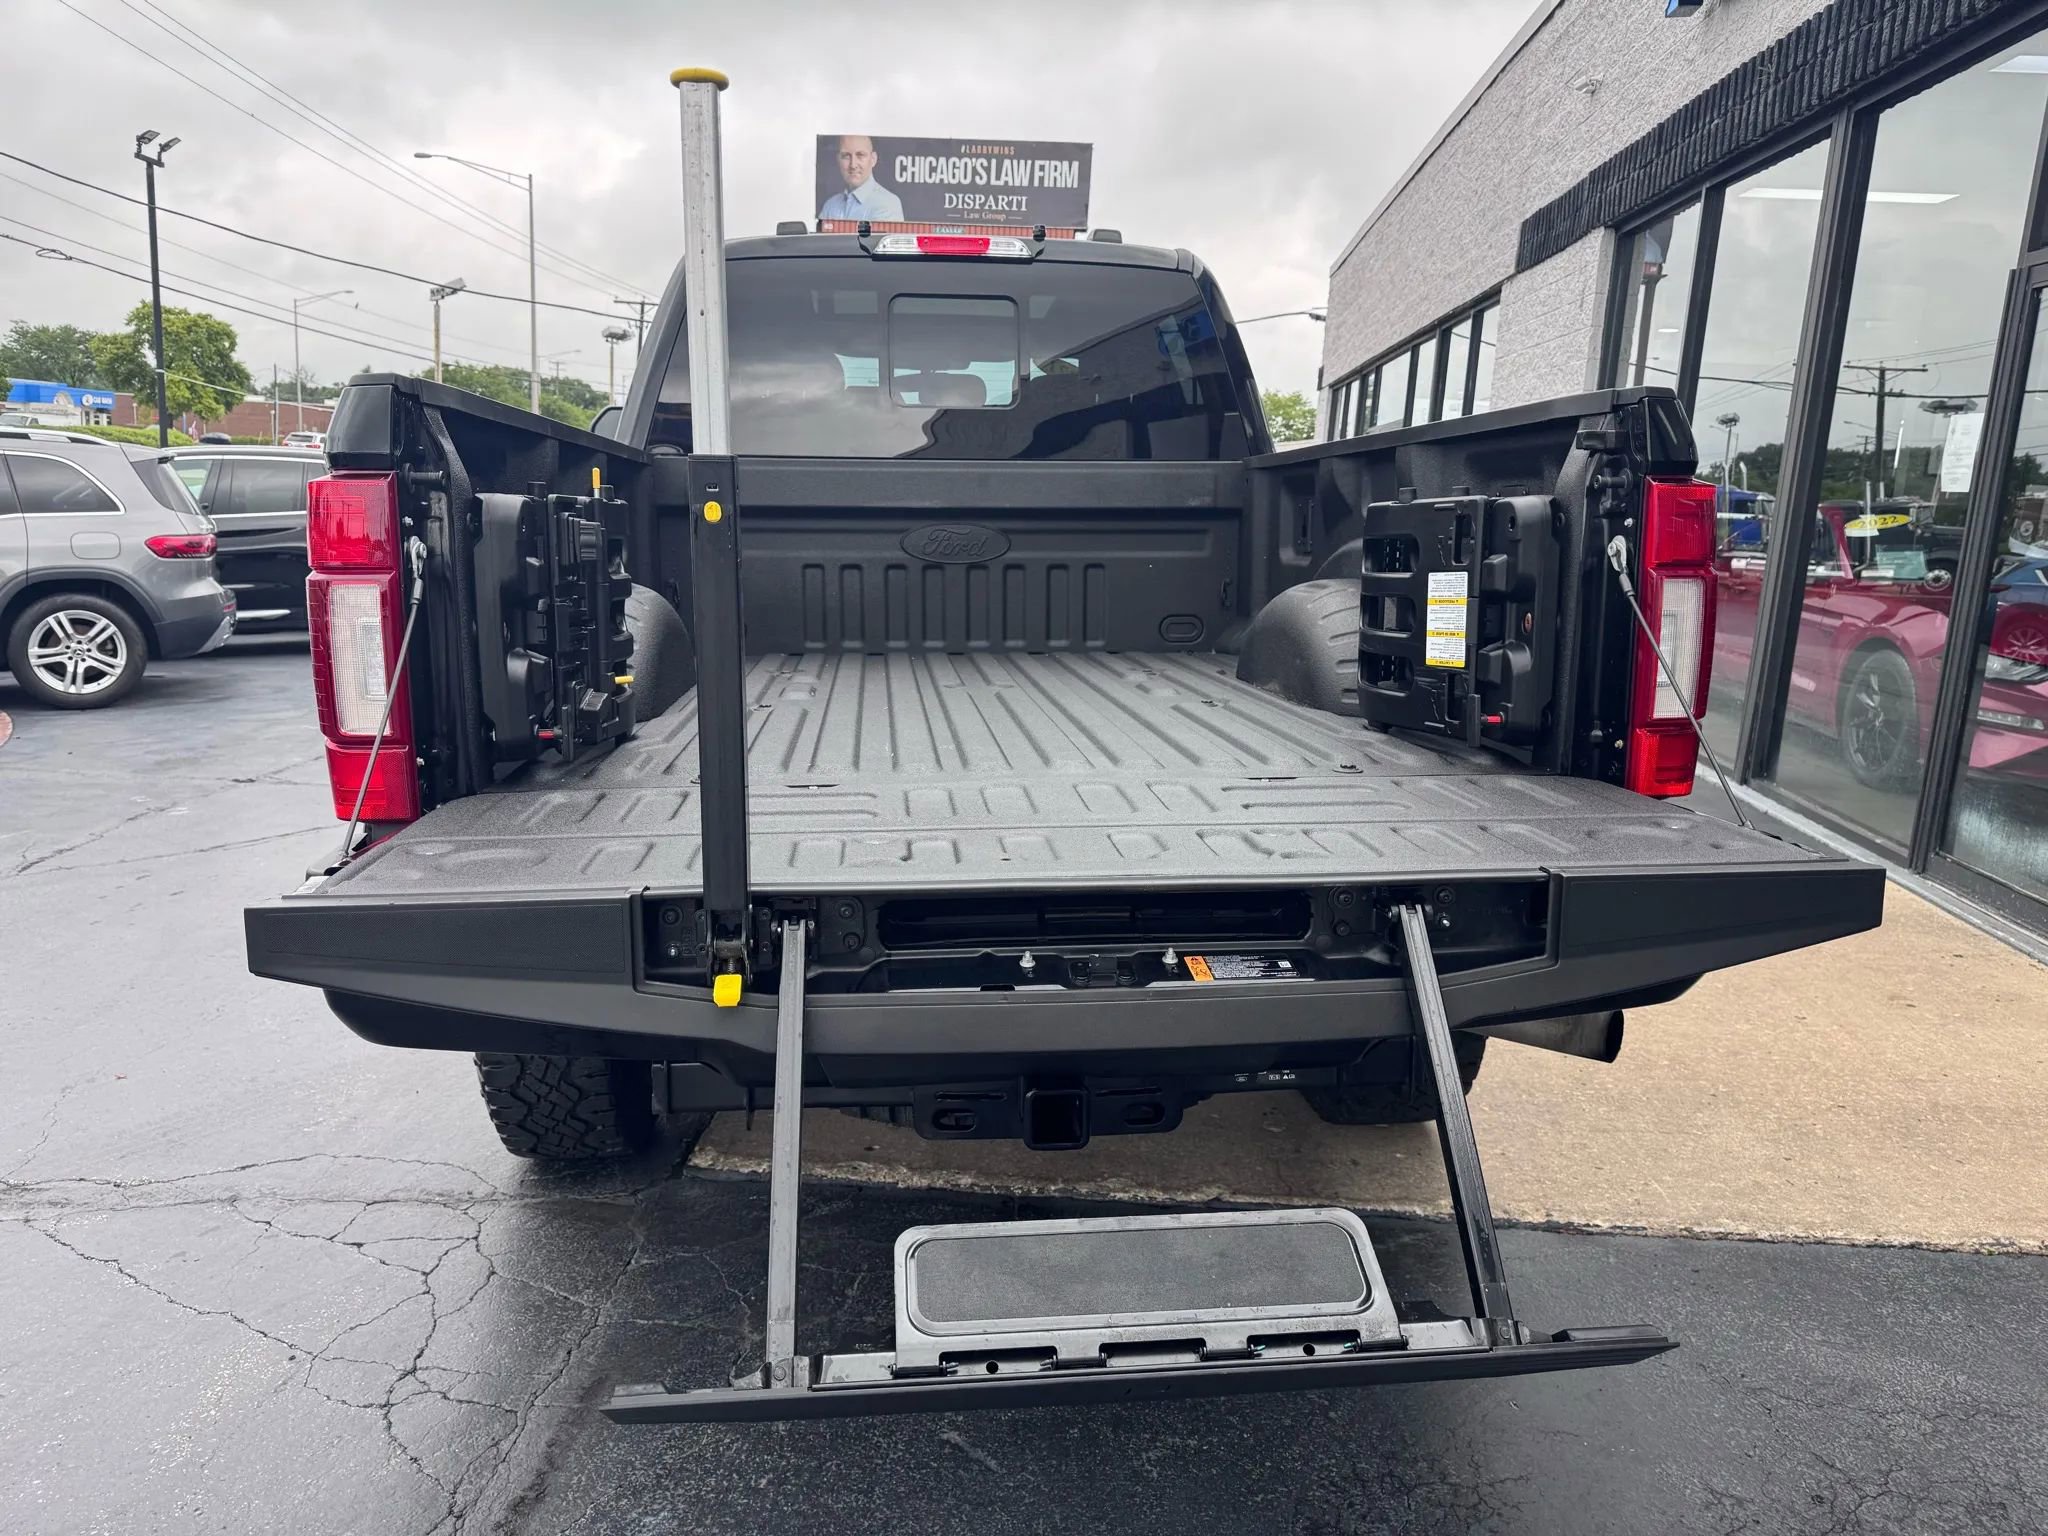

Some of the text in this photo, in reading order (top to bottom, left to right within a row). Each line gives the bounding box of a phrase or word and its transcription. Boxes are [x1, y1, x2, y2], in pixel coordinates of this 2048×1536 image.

[895, 155, 1080, 188] CHICAGO'S LAW FIRM
[944, 193, 1028, 211] DISPARTI
[964, 211, 1006, 221] Law Group
[1857, 516, 1899, 529] 2022
[922, 528, 989, 557] Ford
